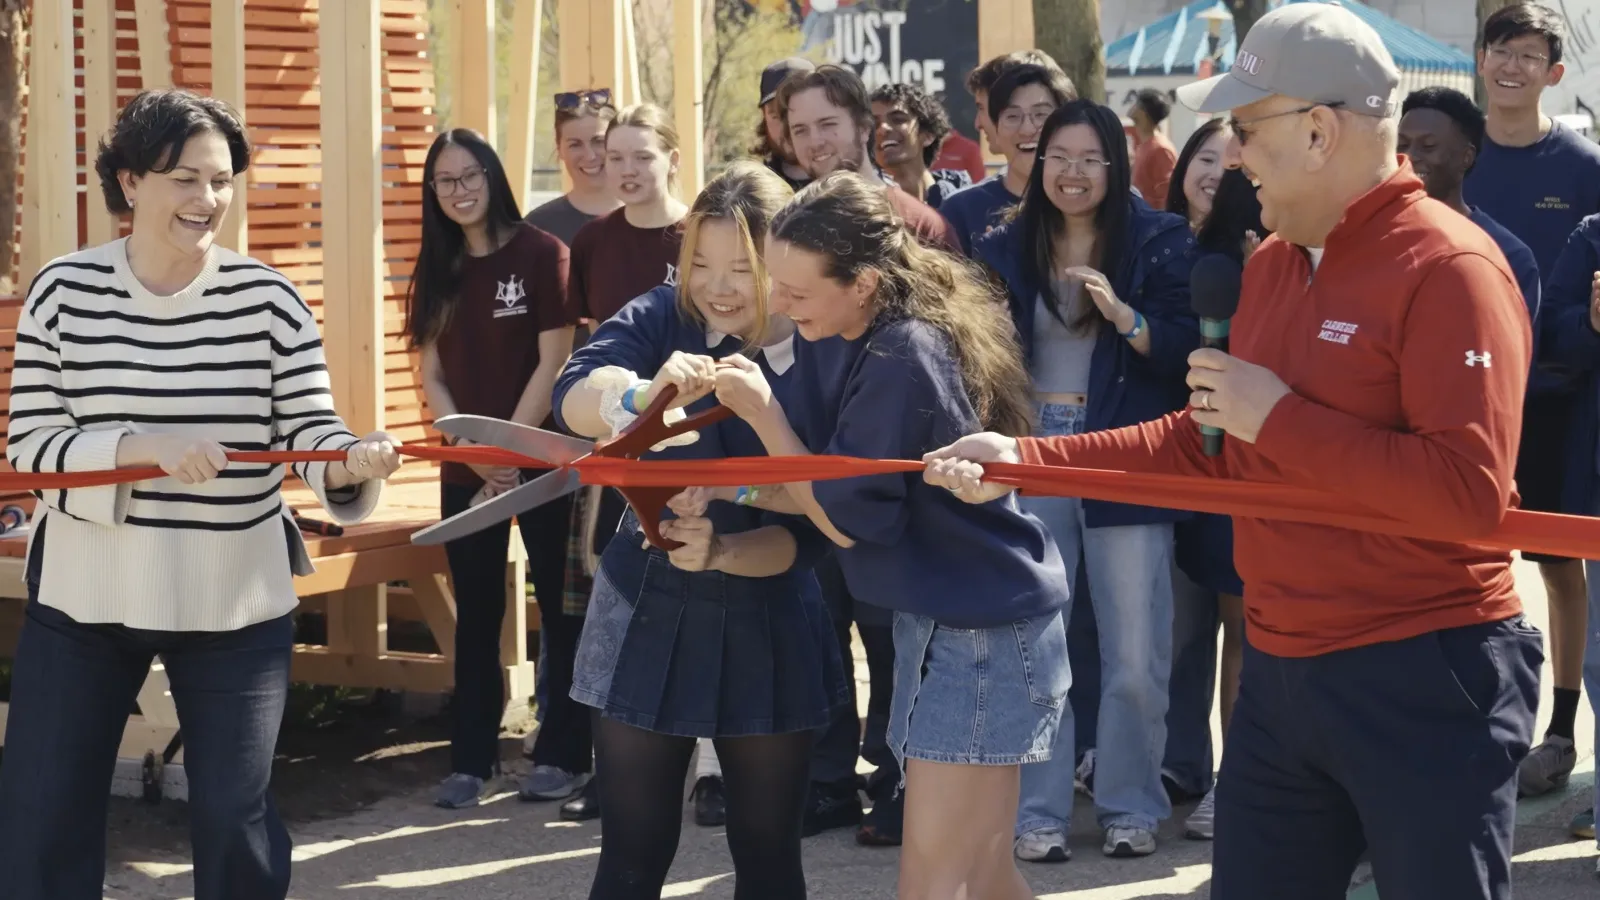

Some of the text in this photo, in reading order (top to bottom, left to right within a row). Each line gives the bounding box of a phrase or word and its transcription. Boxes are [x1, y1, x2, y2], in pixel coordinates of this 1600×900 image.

[826, 10, 907, 84] JUST
[1236, 49, 1264, 76] MU
[840, 59, 945, 96] ANCE
[1317, 329, 1350, 345] MELLON
[1321, 319, 1359, 334] CARNEGIE
